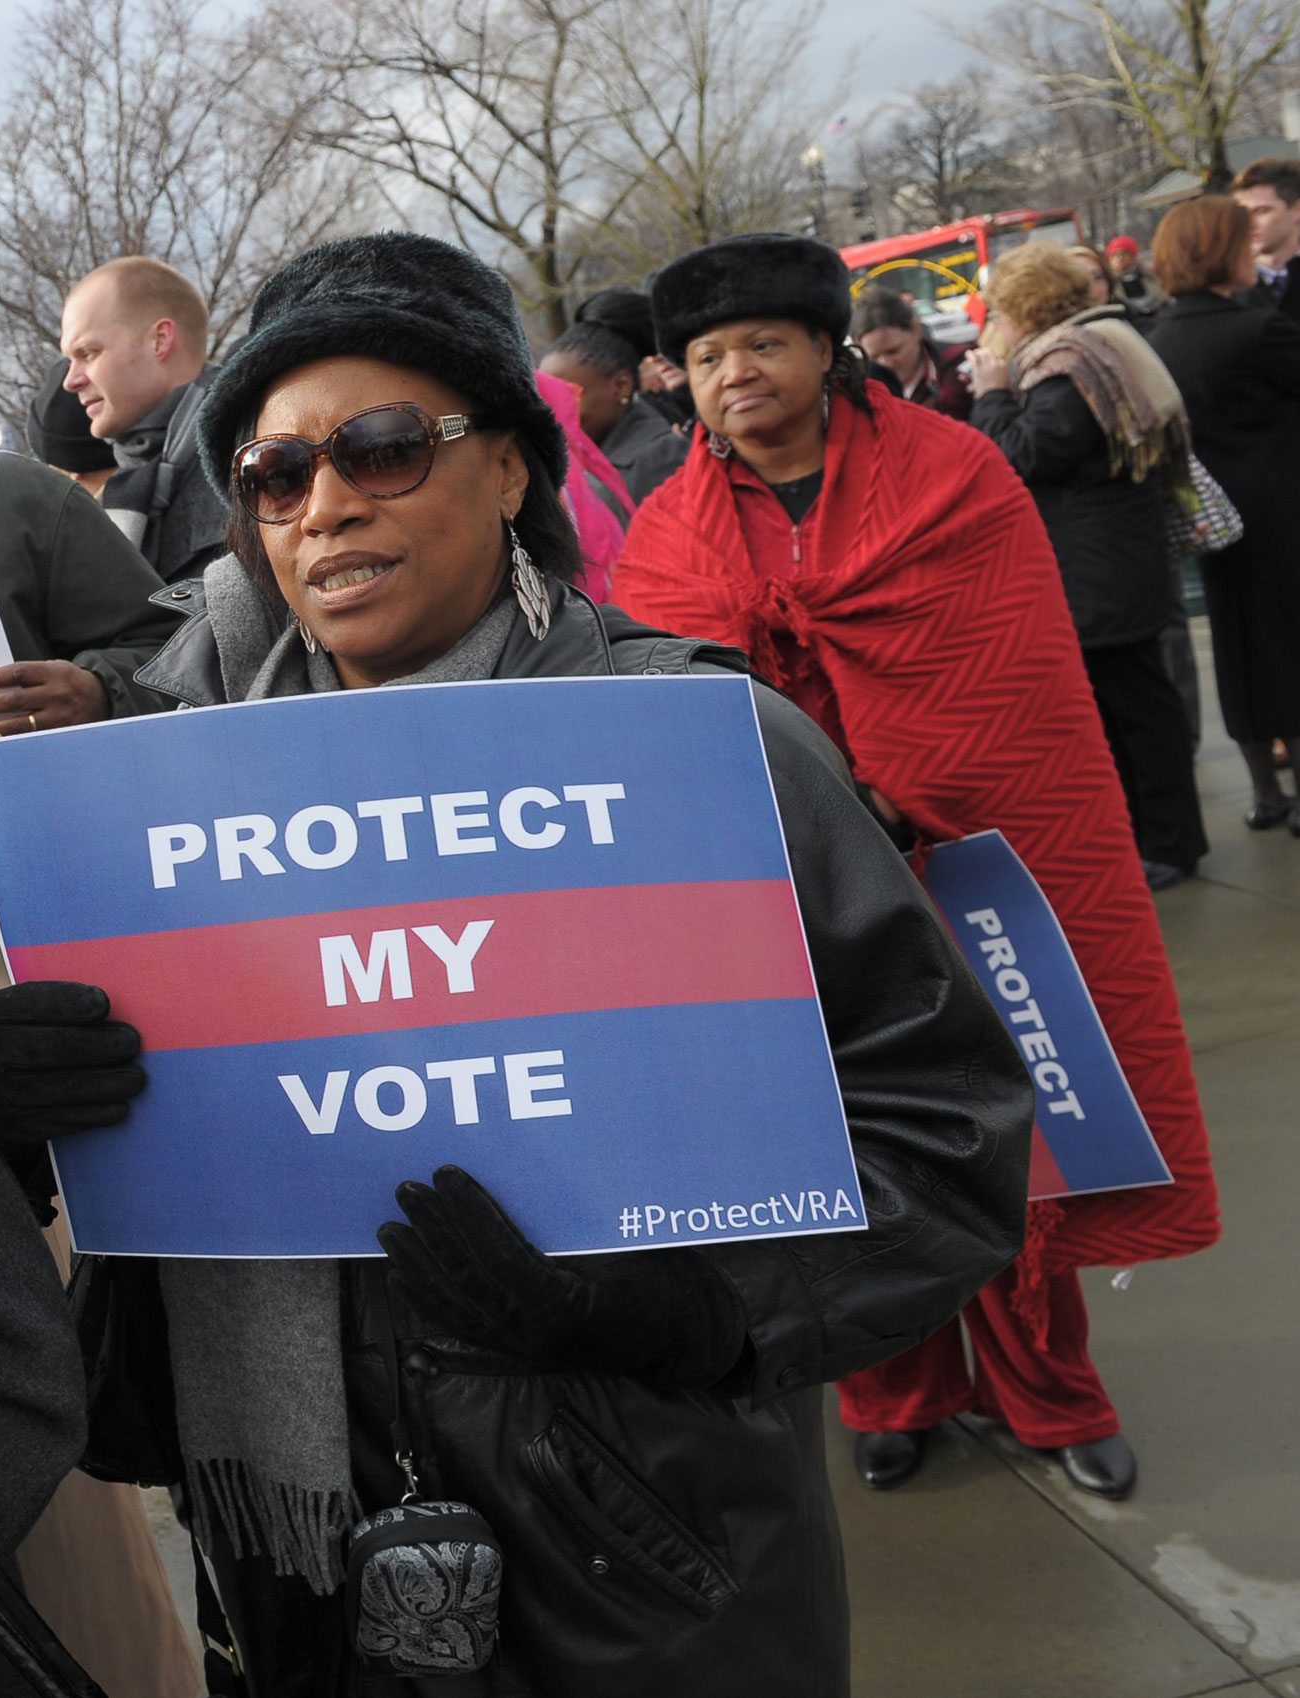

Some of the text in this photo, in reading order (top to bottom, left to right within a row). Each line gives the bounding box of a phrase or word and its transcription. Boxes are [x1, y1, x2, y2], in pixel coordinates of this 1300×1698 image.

[147, 783, 626, 889] PROTECT
[319, 919, 496, 1007] MY
[964, 907, 1086, 1121] PROTECT
[277, 1049, 573, 1135] VOTE
[618, 1188, 858, 1239] #ProtectVRA
